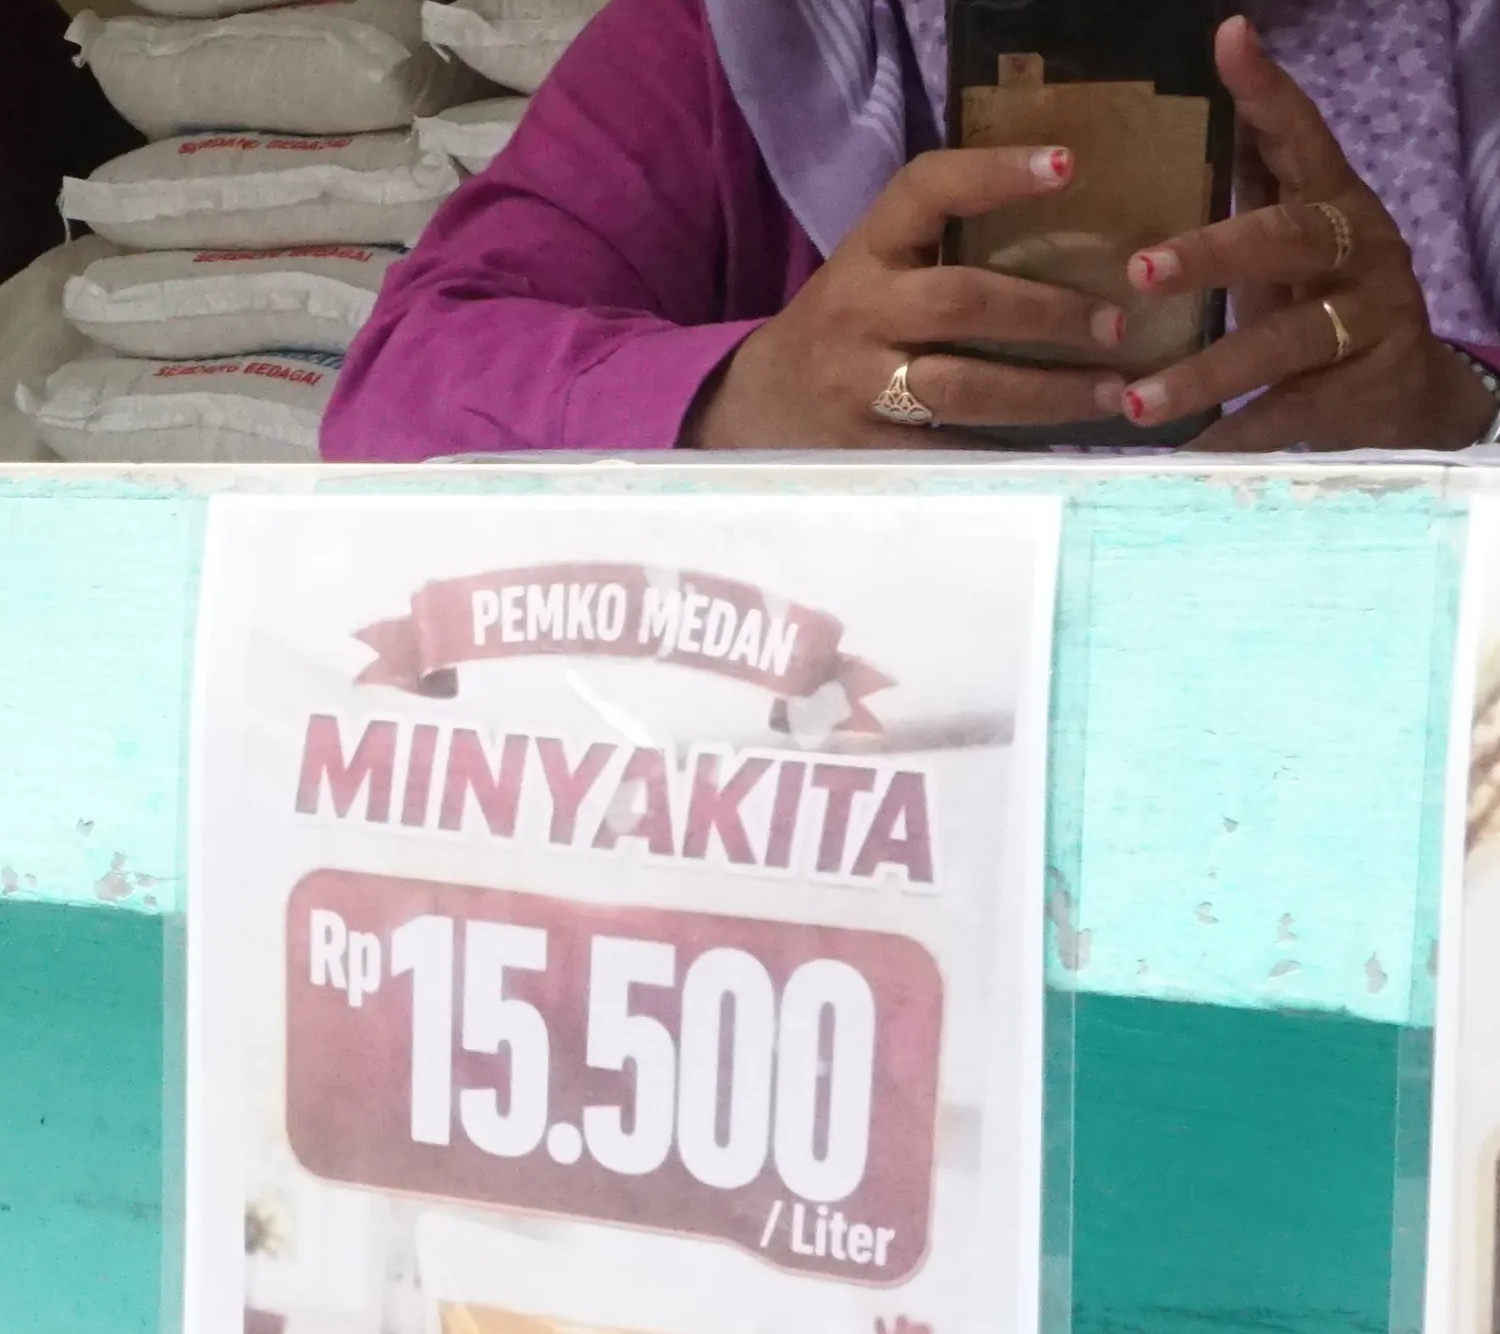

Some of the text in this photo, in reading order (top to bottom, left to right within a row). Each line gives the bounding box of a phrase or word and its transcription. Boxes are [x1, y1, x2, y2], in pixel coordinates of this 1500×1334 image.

[242, 361, 324, 386] BEDAGAI
[471, 582, 800, 678] PEMKO MEDAN
[294, 712, 936, 887] MINYAKITA
